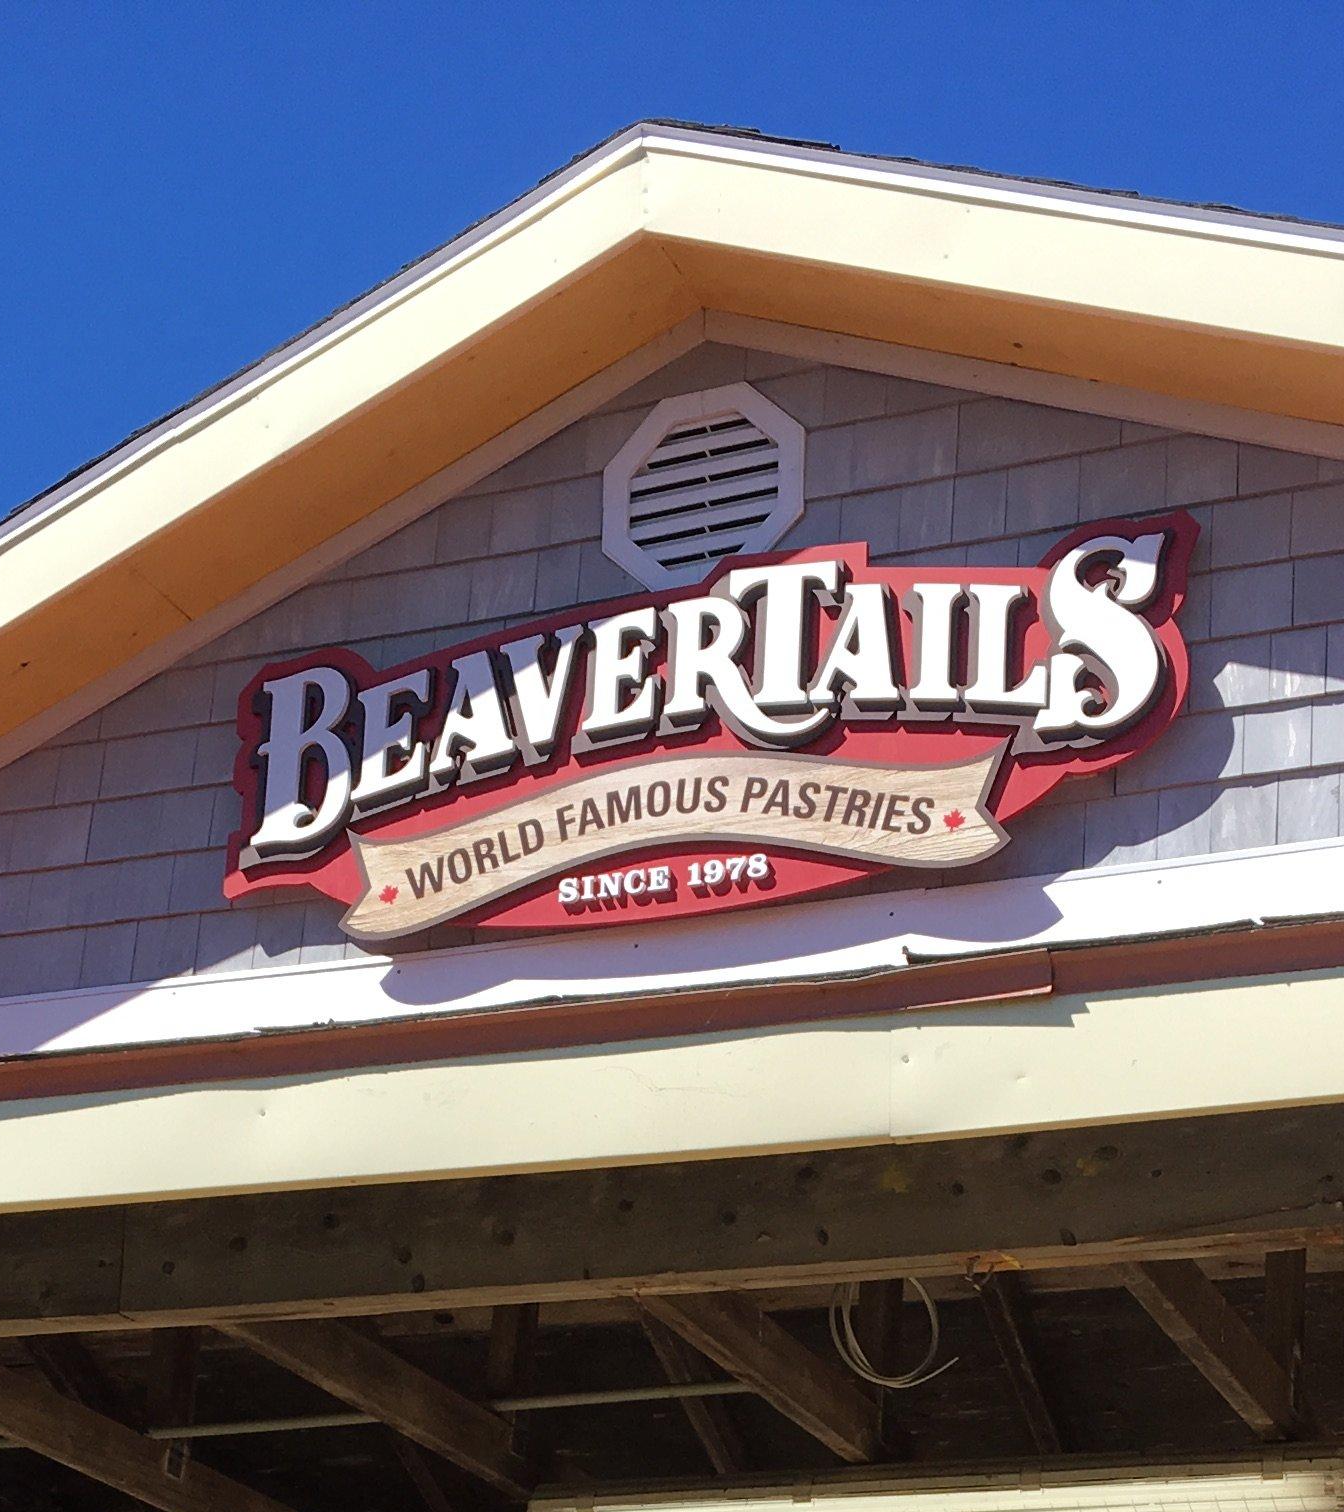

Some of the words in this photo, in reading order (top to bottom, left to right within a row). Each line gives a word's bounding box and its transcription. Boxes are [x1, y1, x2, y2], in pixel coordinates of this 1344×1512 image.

[248, 532, 1166, 850] BEAVERTAILS
[405, 818, 546, 899] WORLD
[557, 775, 729, 843] FAMOUS
[741, 776, 934, 835] PASTRIES
[557, 864, 672, 906] SINCE
[685, 854, 770, 890] 1978
